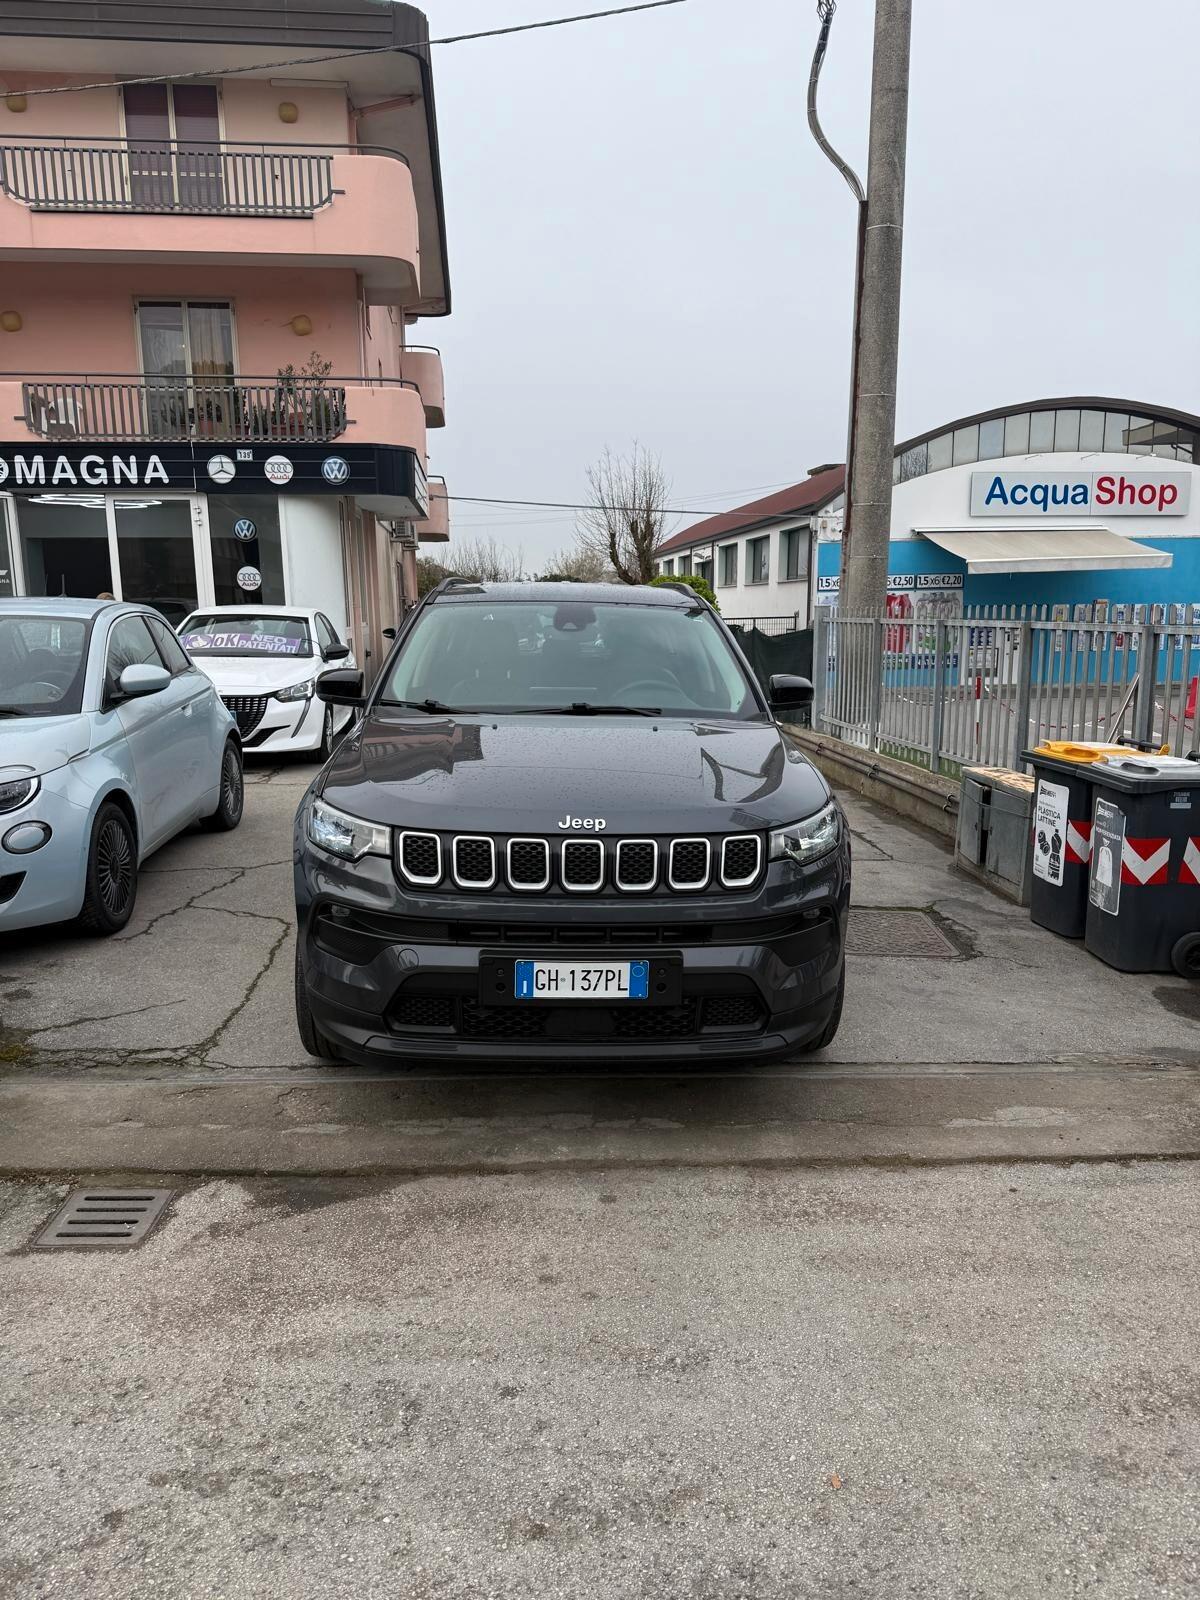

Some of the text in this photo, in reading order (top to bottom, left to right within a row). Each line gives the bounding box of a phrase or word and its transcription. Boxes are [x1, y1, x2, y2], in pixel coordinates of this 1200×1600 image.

[985, 476, 1178, 512] Acqua Shop
[893, 576, 913, 587] €2,50
[942, 575, 962, 586] €2,20
[239, 640, 297, 653] PATENTATI
[250, 634, 287, 645] NEO
[1038, 805, 1061, 820] PLASTICA
[558, 815, 606, 831] Jeep
[1038, 814, 1057, 828] LATTINE
[535, 969, 559, 991] GH
[570, 969, 628, 991] 137PL
